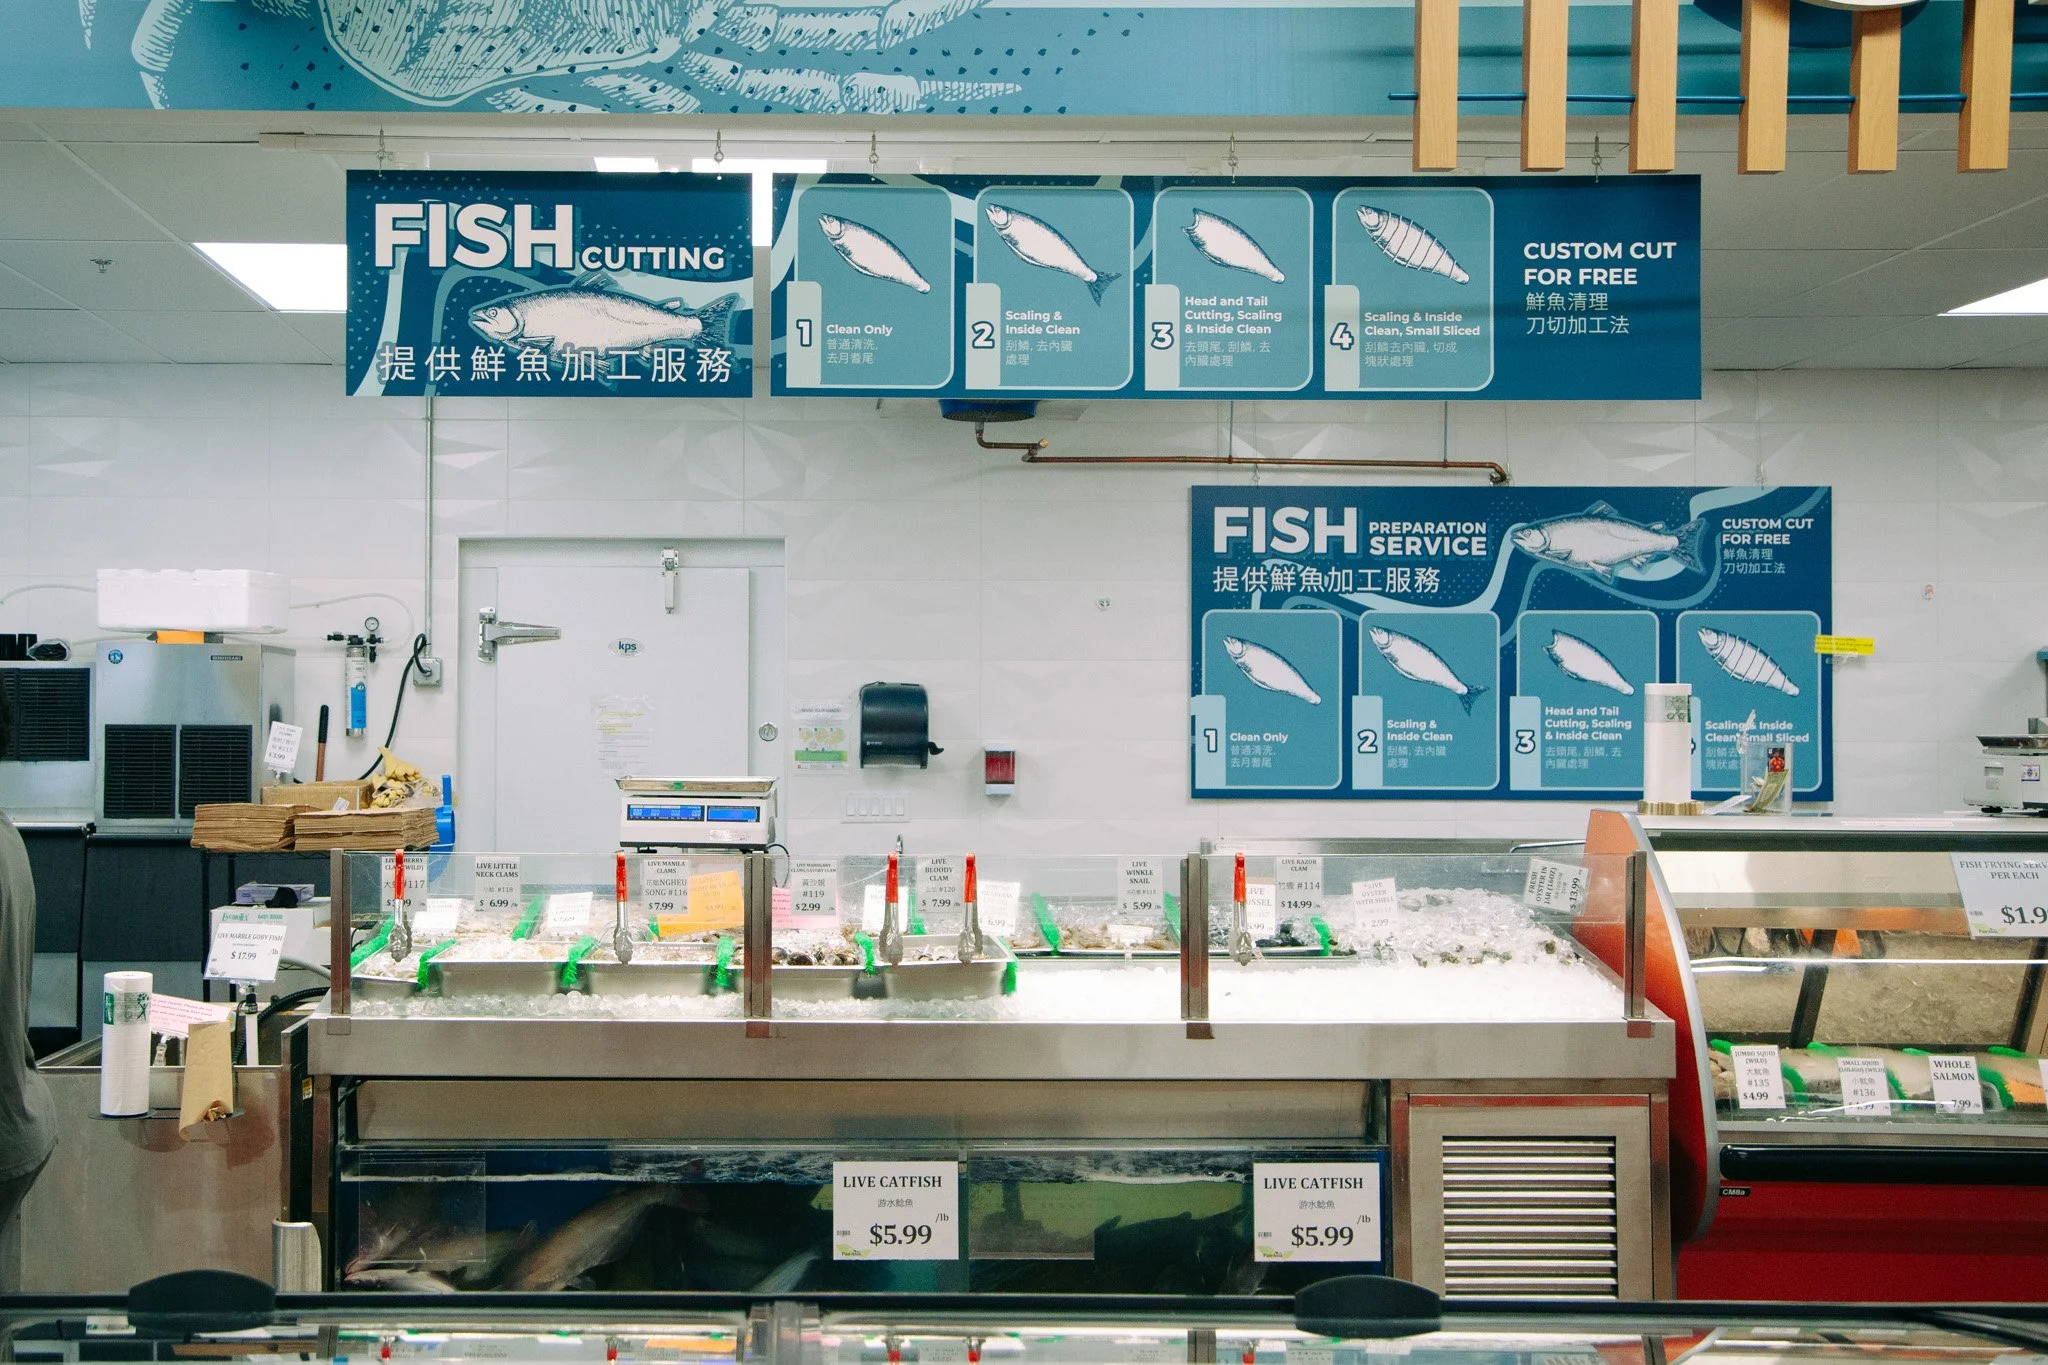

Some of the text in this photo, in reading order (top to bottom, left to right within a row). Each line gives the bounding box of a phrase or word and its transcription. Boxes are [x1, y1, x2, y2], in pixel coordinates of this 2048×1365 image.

[375, 203, 724, 271] FISH CUTTING
[1523, 242, 1677, 260] CUSTOM CUT
[1524, 268, 1637, 285] FOR FREE
[1185, 296, 1268, 306] Head and Tail
[1525, 292, 1609, 312] 鮮魚清理
[1005, 310, 1062, 322] Scaling &
[1185, 310, 1282, 323] Cutting, Scaling
[1364, 312, 1463, 324] Scaling & Inside
[826, 324, 893, 336] Clean Only
[1005, 324, 1080, 334] Inside Clean
[1185, 324, 1272, 334] & Inside Clean
[1526, 315, 1629, 335] 刀切加工法
[796, 319, 812, 347] 1
[972, 321, 995, 349] 2
[1151, 322, 1174, 349] 3
[1330, 322, 1354, 350] 4
[1364, 326, 1480, 337] Clean, Small Sliced
[1259, 341, 1271, 353] 去
[1433, 341, 1457, 353] 切成
[380, 345, 732, 383] 提供鮮魚加工服務
[1213, 506, 1357, 553] FISH
[1369, 521, 1487, 534] PREPARATION
[1722, 518, 1814, 529] CUSTOM CUT
[1722, 534, 1790, 545] FOR FREE
[1369, 536, 1487, 556] SERVICE
[1723, 548, 1774, 560] 鮮魚清理
[1723, 562, 1786, 575] 刀切加工法
[1212, 566, 1440, 594] 提供鮮魚加工服務
[618, 641, 637, 653] kps
[1545, 706, 1619, 716] Head and Tail
[1387, 719, 1437, 731] Scaling &
[1545, 719, 1632, 730] Cutting, Scaling
[1705, 721, 1793, 731] Scaling Inside
[1204, 729, 1217, 752] 1
[1230, 732, 1288, 744] Clean Only
[1358, 729, 1378, 753] 2
[1387, 731, 1453, 741] Inside Clean
[1515, 729, 1536, 754] 3
[1545, 731, 1622, 741] & Inside Clean
[1776, 733, 1810, 742] Sliced
[1960, 861, 1981, 869] FISH
[1985, 861, 2021, 869] FRYING
[1529, 871, 1537, 893] FRESH
[1536, 875, 1545, 902] OYSTER
[1569, 877, 1580, 902] 13.99
[489, 899, 509, 907] 6.99
[654, 902, 673, 910] 7.99
[801, 903, 820, 911] 2.99
[932, 899, 951, 907] 7.99
[1133, 902, 1152, 910] 5.99
[1287, 900, 1312, 908] 14.99
[237, 952, 257, 960] 17.99
[1933, 1060, 1971, 1068] WHOLE
[1748, 1079, 1769, 1087] #135
[1749, 1092, 1768, 1100] 4.99
[843, 1175, 942, 1188] LIVE CATFISH
[1263, 1177, 1363, 1189] LIVE CATFISH
[935, 1213, 949, 1223] /lb
[1357, 1214, 1371, 1225] /lb
[869, 1223, 932, 1246] $5.99
[1291, 1224, 1354, 1248] $5.99
